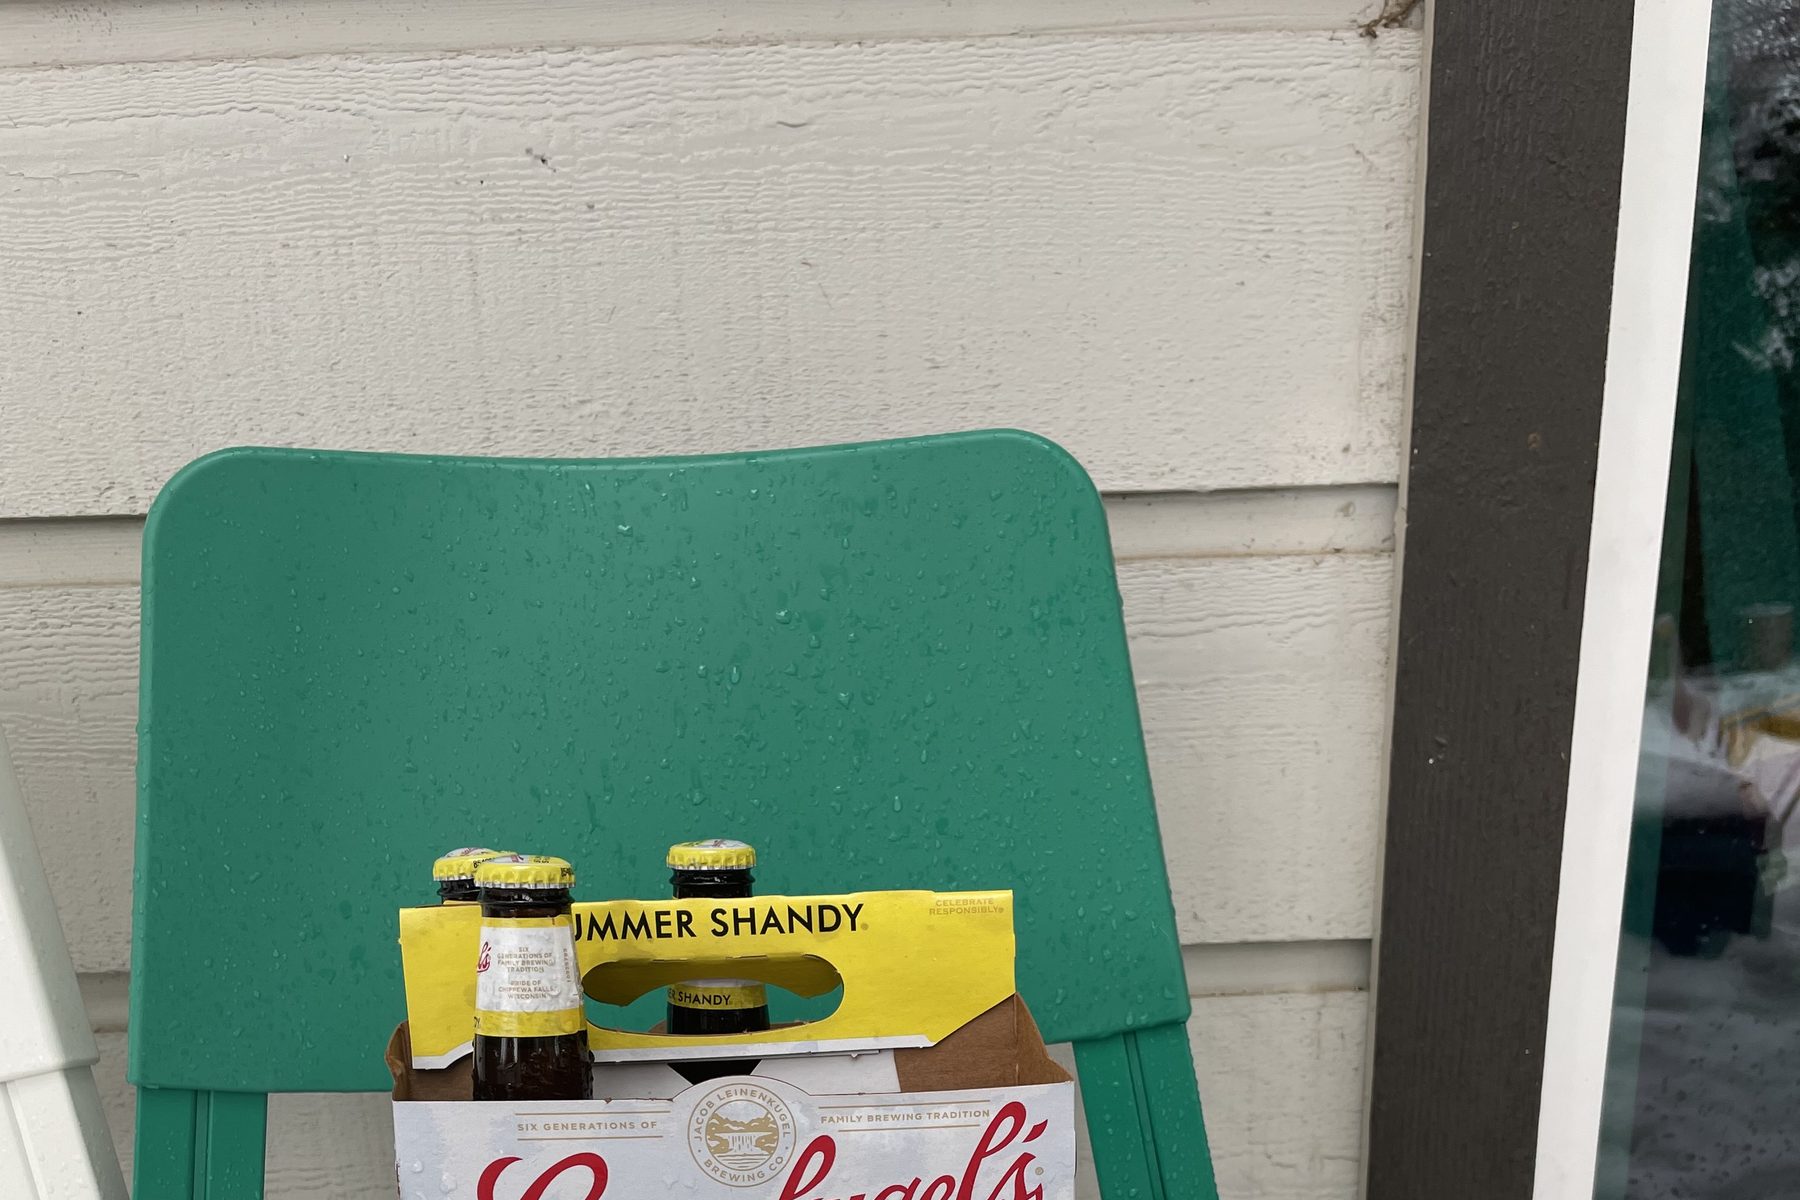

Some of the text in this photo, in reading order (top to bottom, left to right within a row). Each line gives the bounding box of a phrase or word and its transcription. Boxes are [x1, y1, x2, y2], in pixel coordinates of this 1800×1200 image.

[935, 898, 994, 907] CELEBRATE
[710, 903, 864, 938] SHANDY
[678, 991, 731, 1006] SHANDY
[694, 1088, 791, 1142] JACOB LEINENKUGEL
[820, 1109, 991, 1124] FAMILY BREWING TRADITION
[517, 1121, 658, 1132] SIX GENERATIONS OF
[704, 1158, 766, 1183] BREWING
